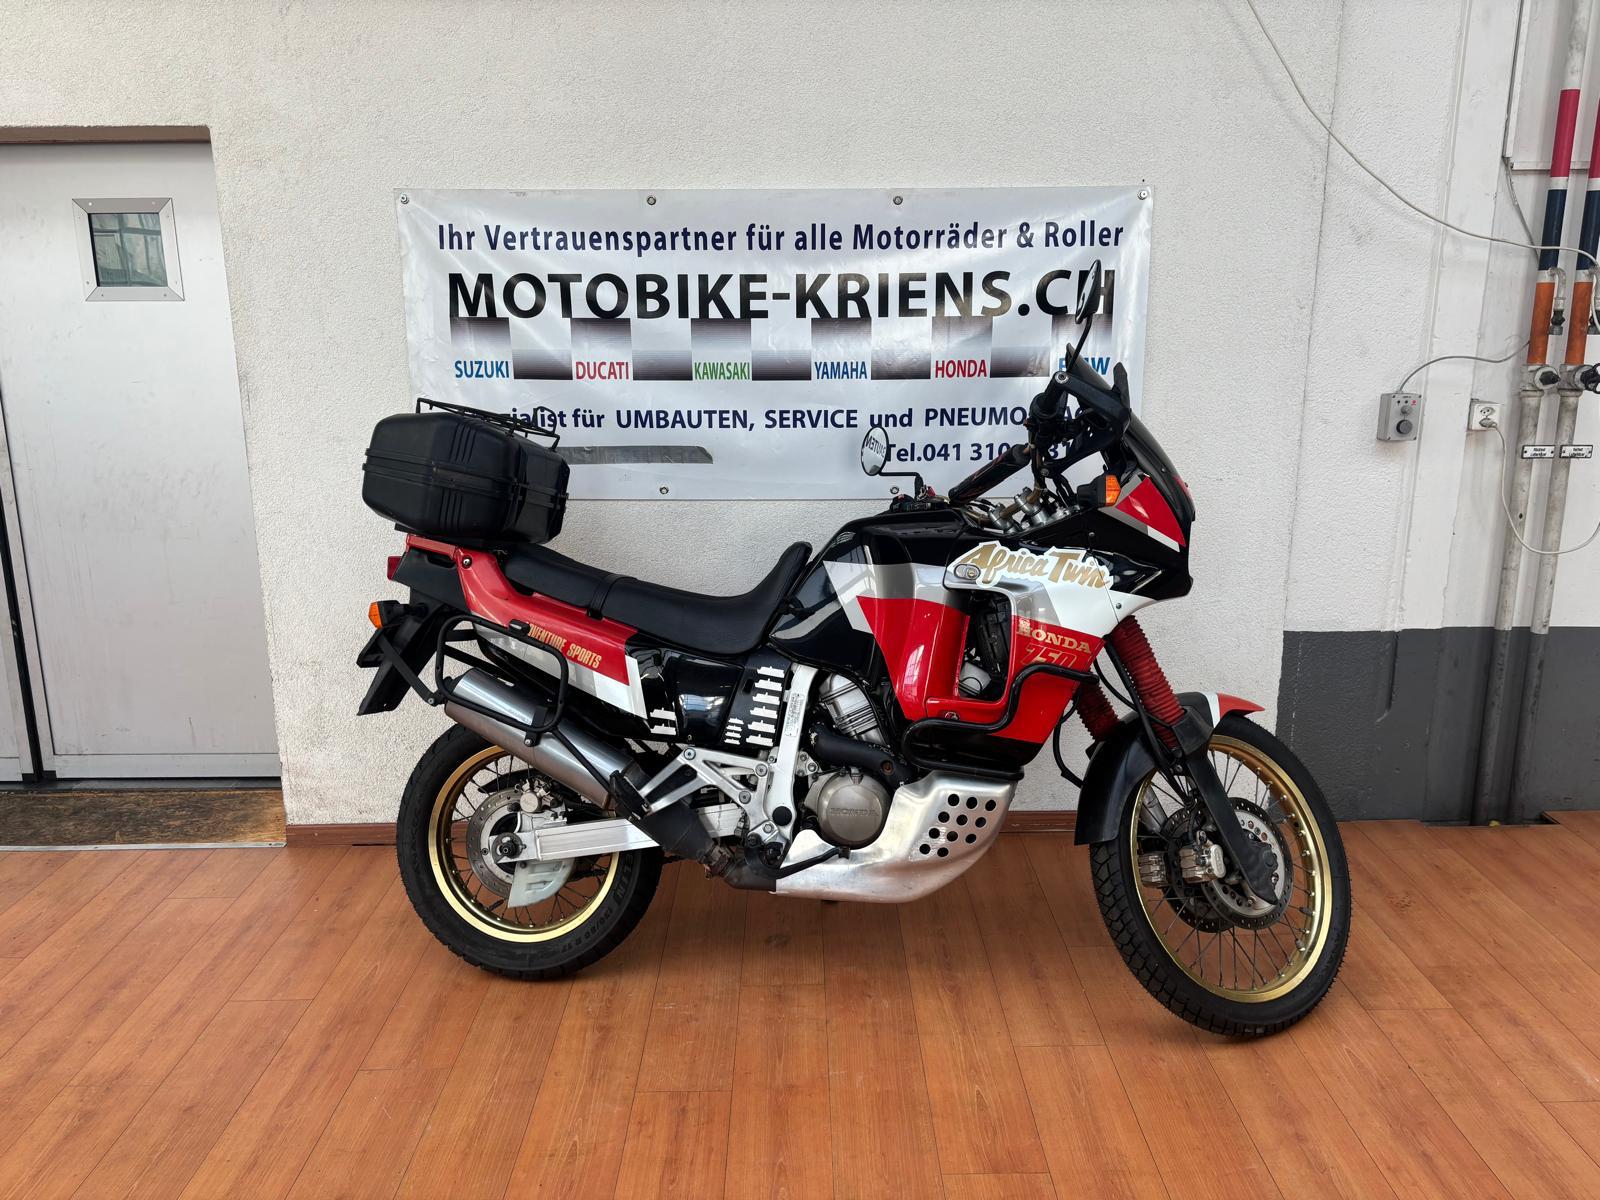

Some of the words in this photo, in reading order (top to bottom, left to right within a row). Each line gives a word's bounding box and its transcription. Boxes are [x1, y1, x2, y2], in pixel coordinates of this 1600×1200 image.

[438, 224, 475, 250] Ihr
[484, 225, 736, 256] Vertrauenspartner
[746, 223, 785, 250] für
[795, 223, 843, 250] alle
[852, 222, 1008, 250] Motorräder
[1016, 221, 1034, 248] &
[1044, 220, 1124, 247] Roller
[448, 269, 1116, 319] MOTOBIKE-KRIENS.CH
[454, 360, 510, 379] SUZUKI
[575, 361, 630, 380] DUCATI
[694, 362, 751, 380] KAWASAKI
[814, 361, 868, 380] YAMAHA
[935, 360, 988, 378] HONDA
[571, 407, 606, 428] für
[615, 409, 756, 432] UMBAUTEN,
[764, 409, 859, 429] SERVICE
[869, 407, 913, 428] und
[952, 541, 1049, 585] Africa
[1047, 549, 1112, 590] Twin
[527, 621, 568, 651] DVENTURE
[565, 642, 603, 669] SPORTS
[1017, 617, 1092, 654] HONDA
